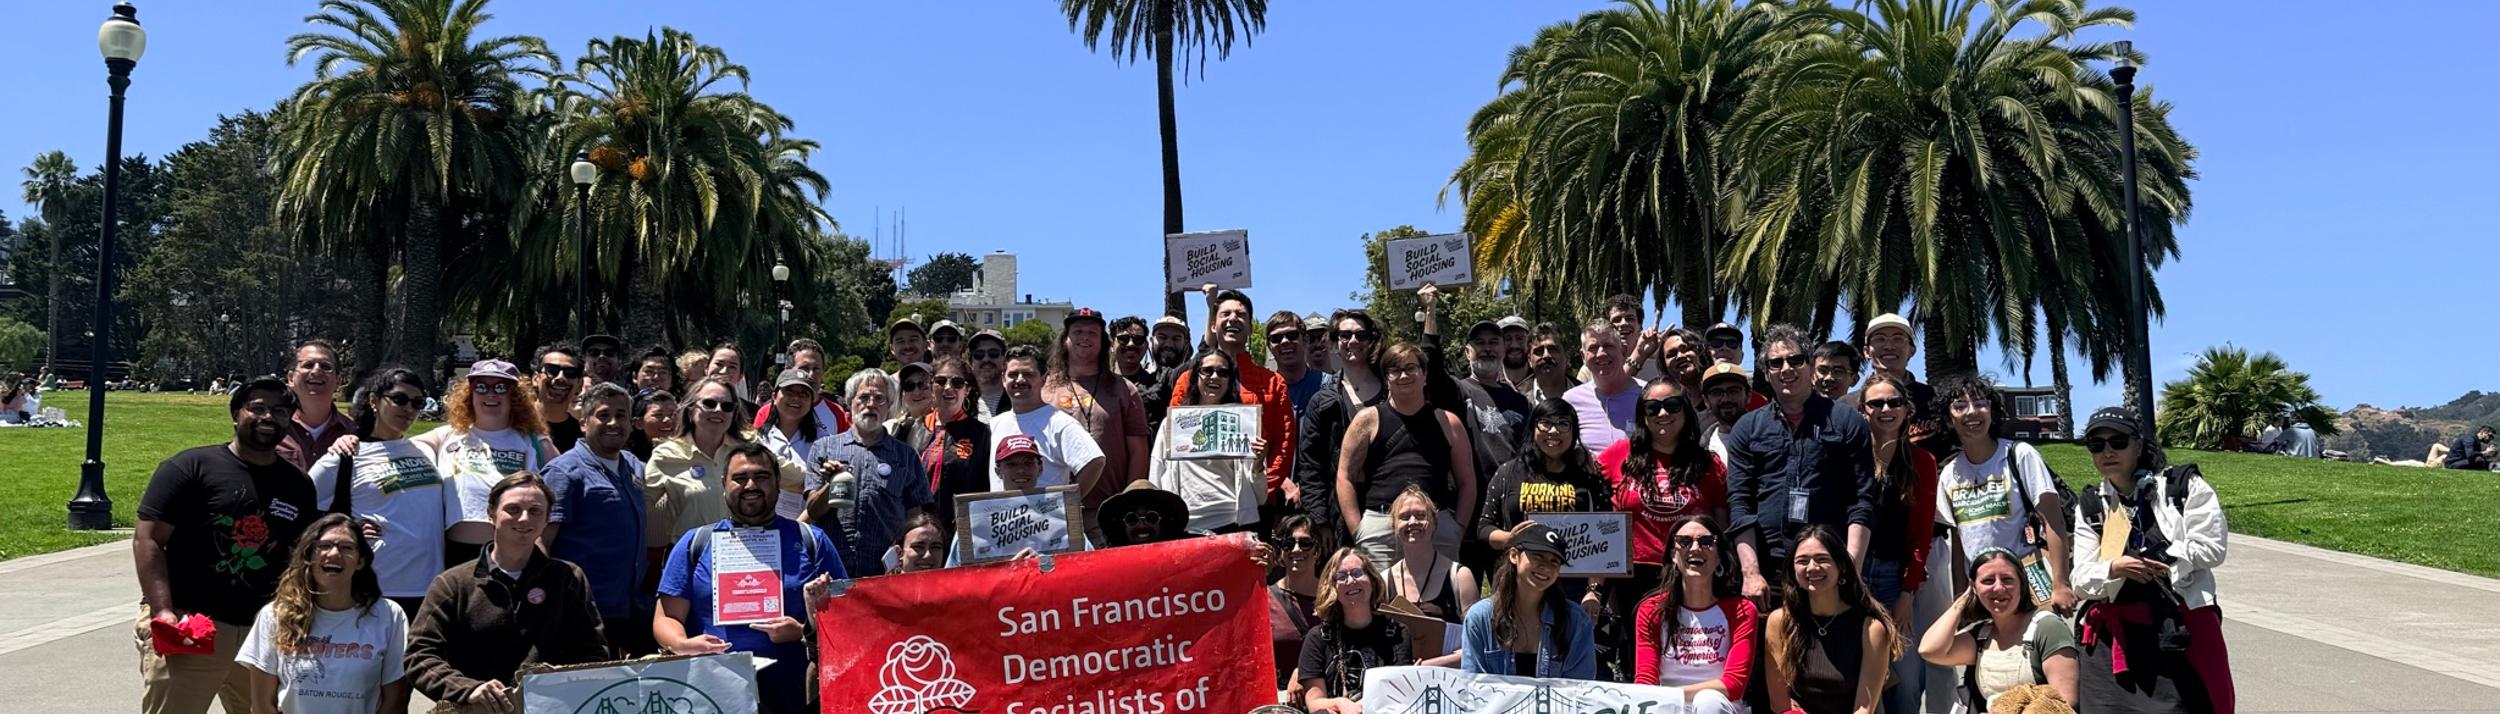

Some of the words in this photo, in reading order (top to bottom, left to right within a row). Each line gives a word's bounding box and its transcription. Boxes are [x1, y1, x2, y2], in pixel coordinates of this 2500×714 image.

[1187, 243, 1217, 261] BUILD
[1187, 252, 1221, 271] SOCIAL
[1405, 243, 1438, 262] BUILD
[1191, 256, 1233, 279] HOUSING
[1405, 253, 1442, 273] SOCIAL
[1410, 257, 1455, 281] HOUSING
[1520, 482, 1576, 498] WORKING
[1952, 481, 2005, 502] BRANEE
[1519, 495, 1576, 512] FAMILIES
[991, 504, 1029, 526] BUILD
[991, 514, 1034, 538] SOCIAL
[996, 519, 1050, 549] HOUSING
[1565, 541, 1608, 561] OUSING
[1566, 534, 1593, 550] CIAL
[998, 606, 1061, 637] San
[1072, 587, 1226, 628] Francisco
[1003, 634, 1194, 685] Democratic
[298, 688, 324, 698] BATON
[1176, 676, 1210, 712] of
